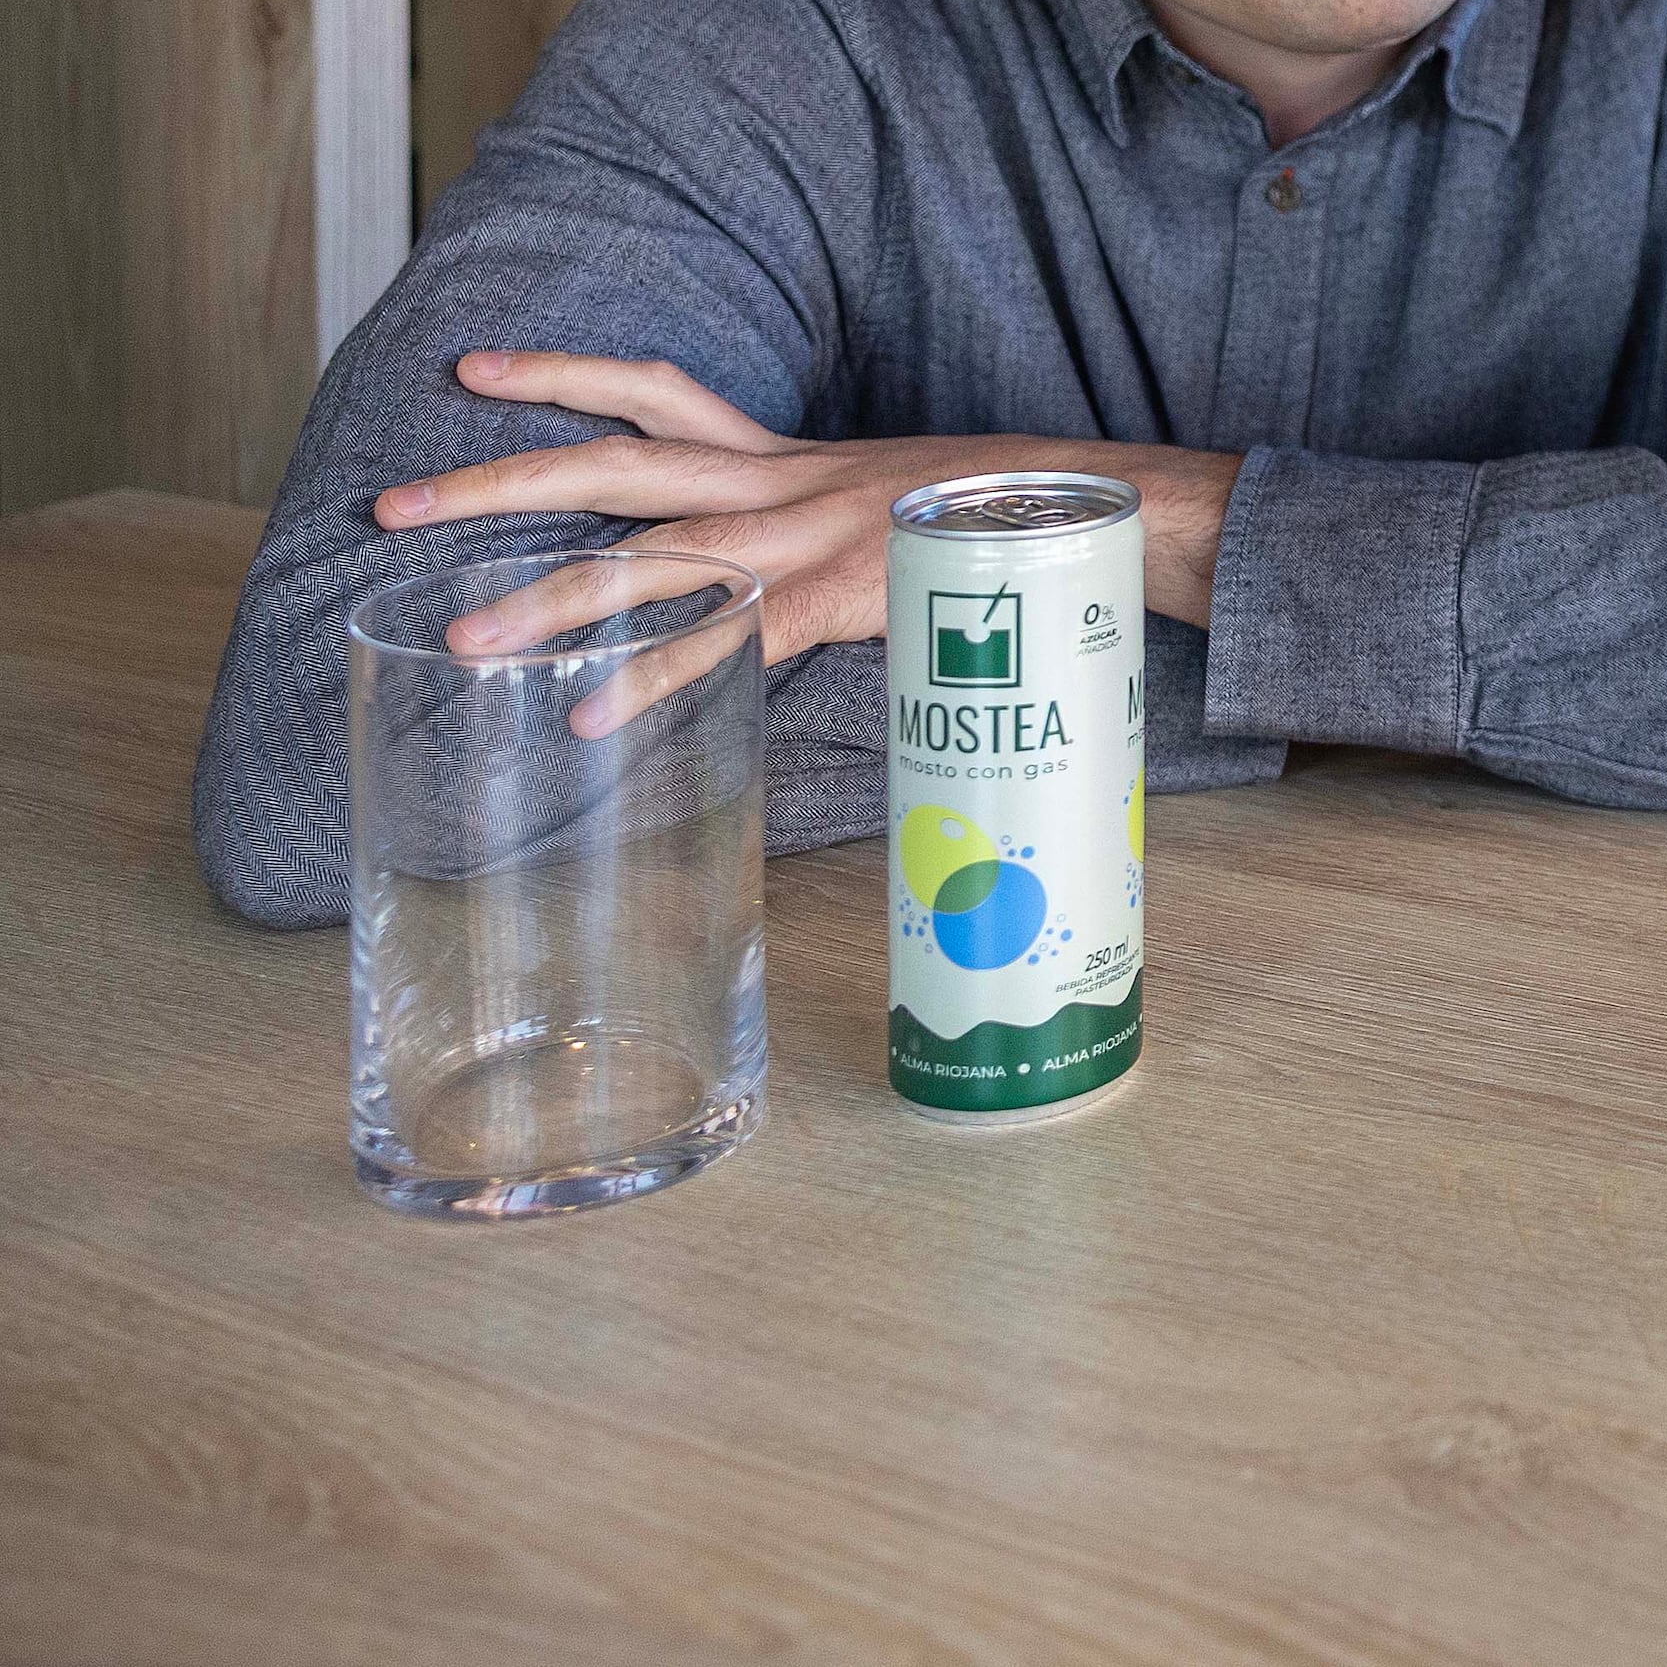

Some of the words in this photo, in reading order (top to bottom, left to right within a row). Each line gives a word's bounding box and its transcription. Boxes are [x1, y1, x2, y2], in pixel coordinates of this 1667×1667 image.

[900, 695, 1068, 754] MOSTEA
[900, 755, 957, 778] mosto
[967, 763, 1013, 779] con
[1024, 758, 1068, 780] gas
[1085, 946, 1111, 972] 250
[1114, 934, 1129, 961] ml
[1056, 976, 1094, 992] BEBIDA
[1042, 1049, 1090, 1073] ALMA
[1092, 1021, 1138, 1057] RIOJANA
[900, 1053, 933, 1074] ALMA
[934, 1063, 1007, 1079] RIOJANA
